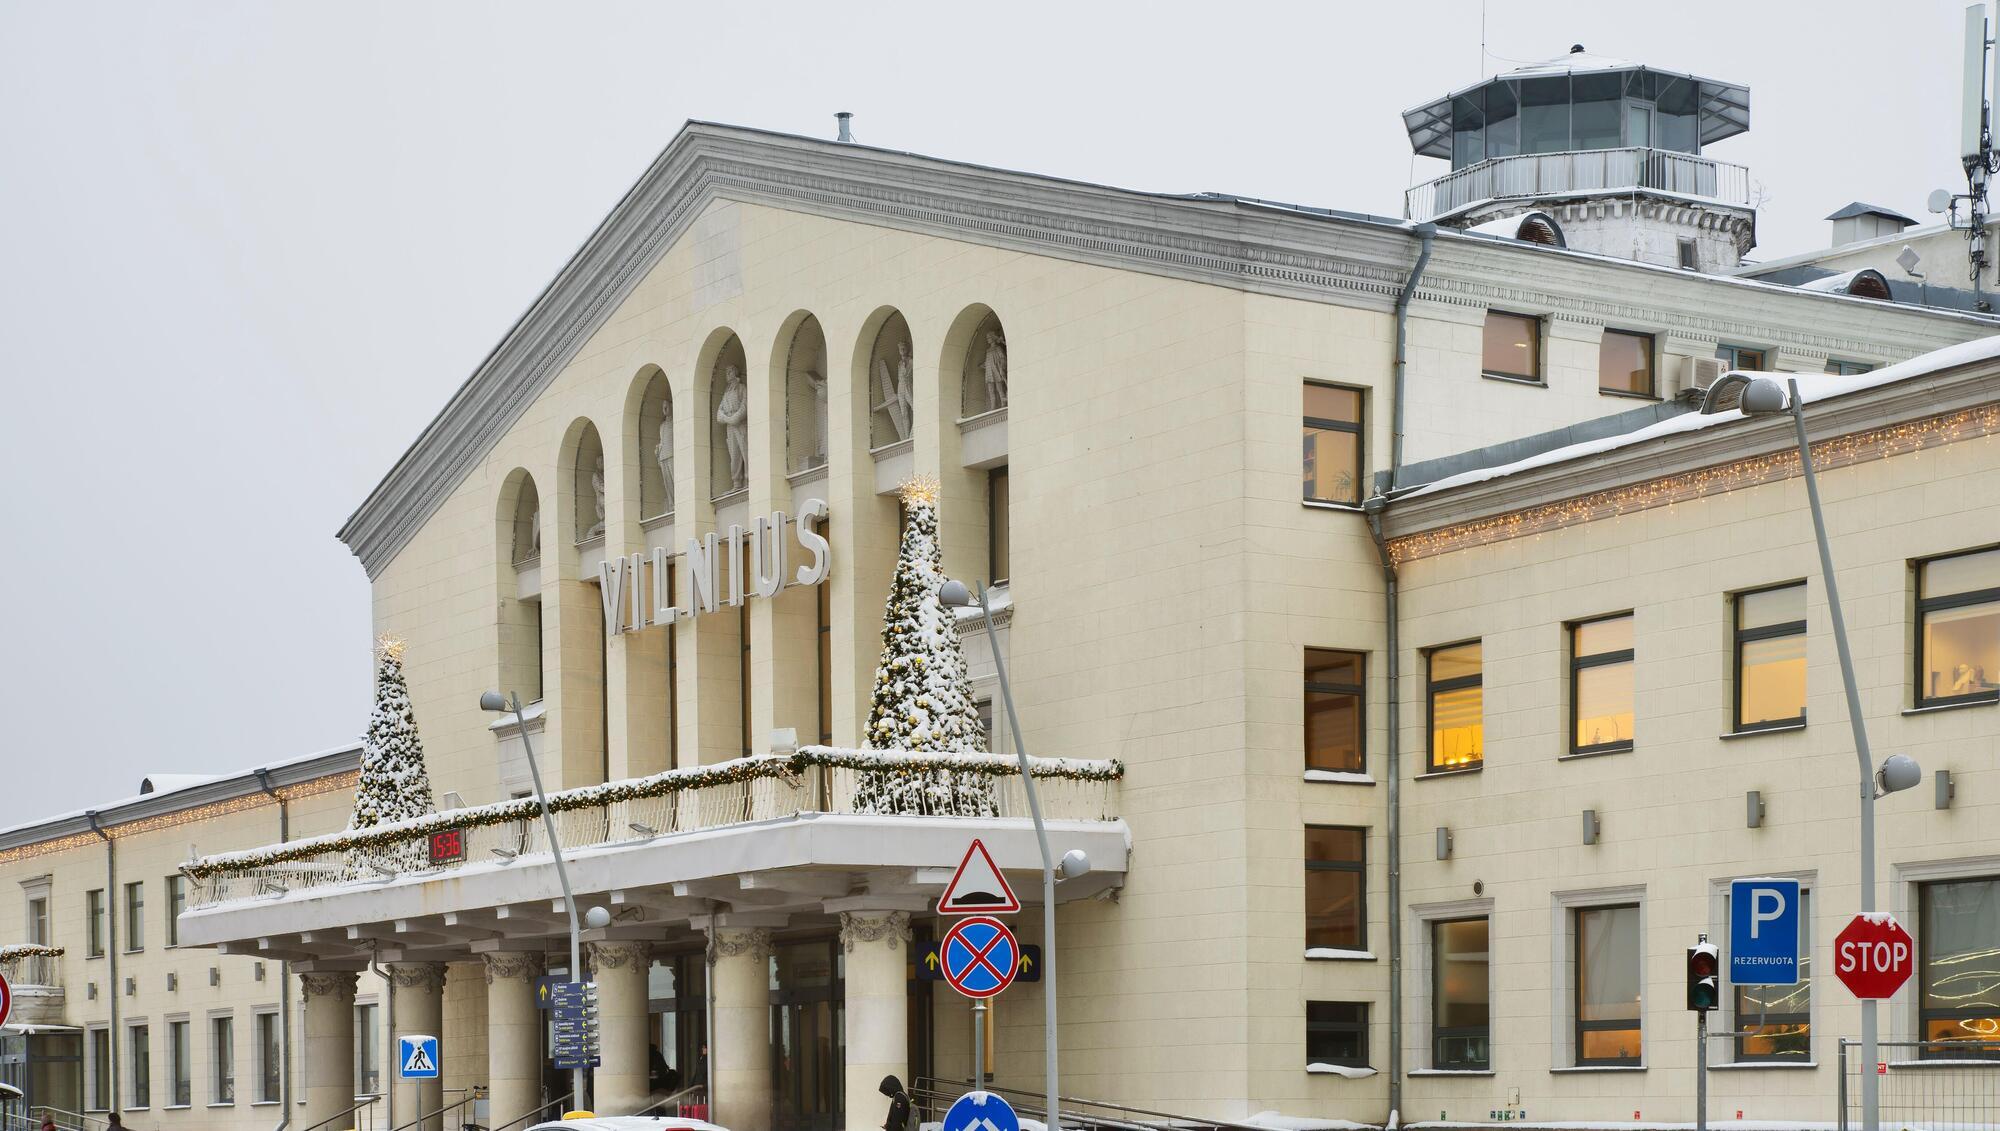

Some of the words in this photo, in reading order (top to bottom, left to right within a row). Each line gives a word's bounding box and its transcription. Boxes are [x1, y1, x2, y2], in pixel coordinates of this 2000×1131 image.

[599, 498, 831, 635] VILNIUS
[433, 832, 461, 858] 15:36
[1751, 888, 1786, 939] P
[1734, 956, 1793, 965] REZERVUOTA
[1840, 941, 1907, 973] STOP
